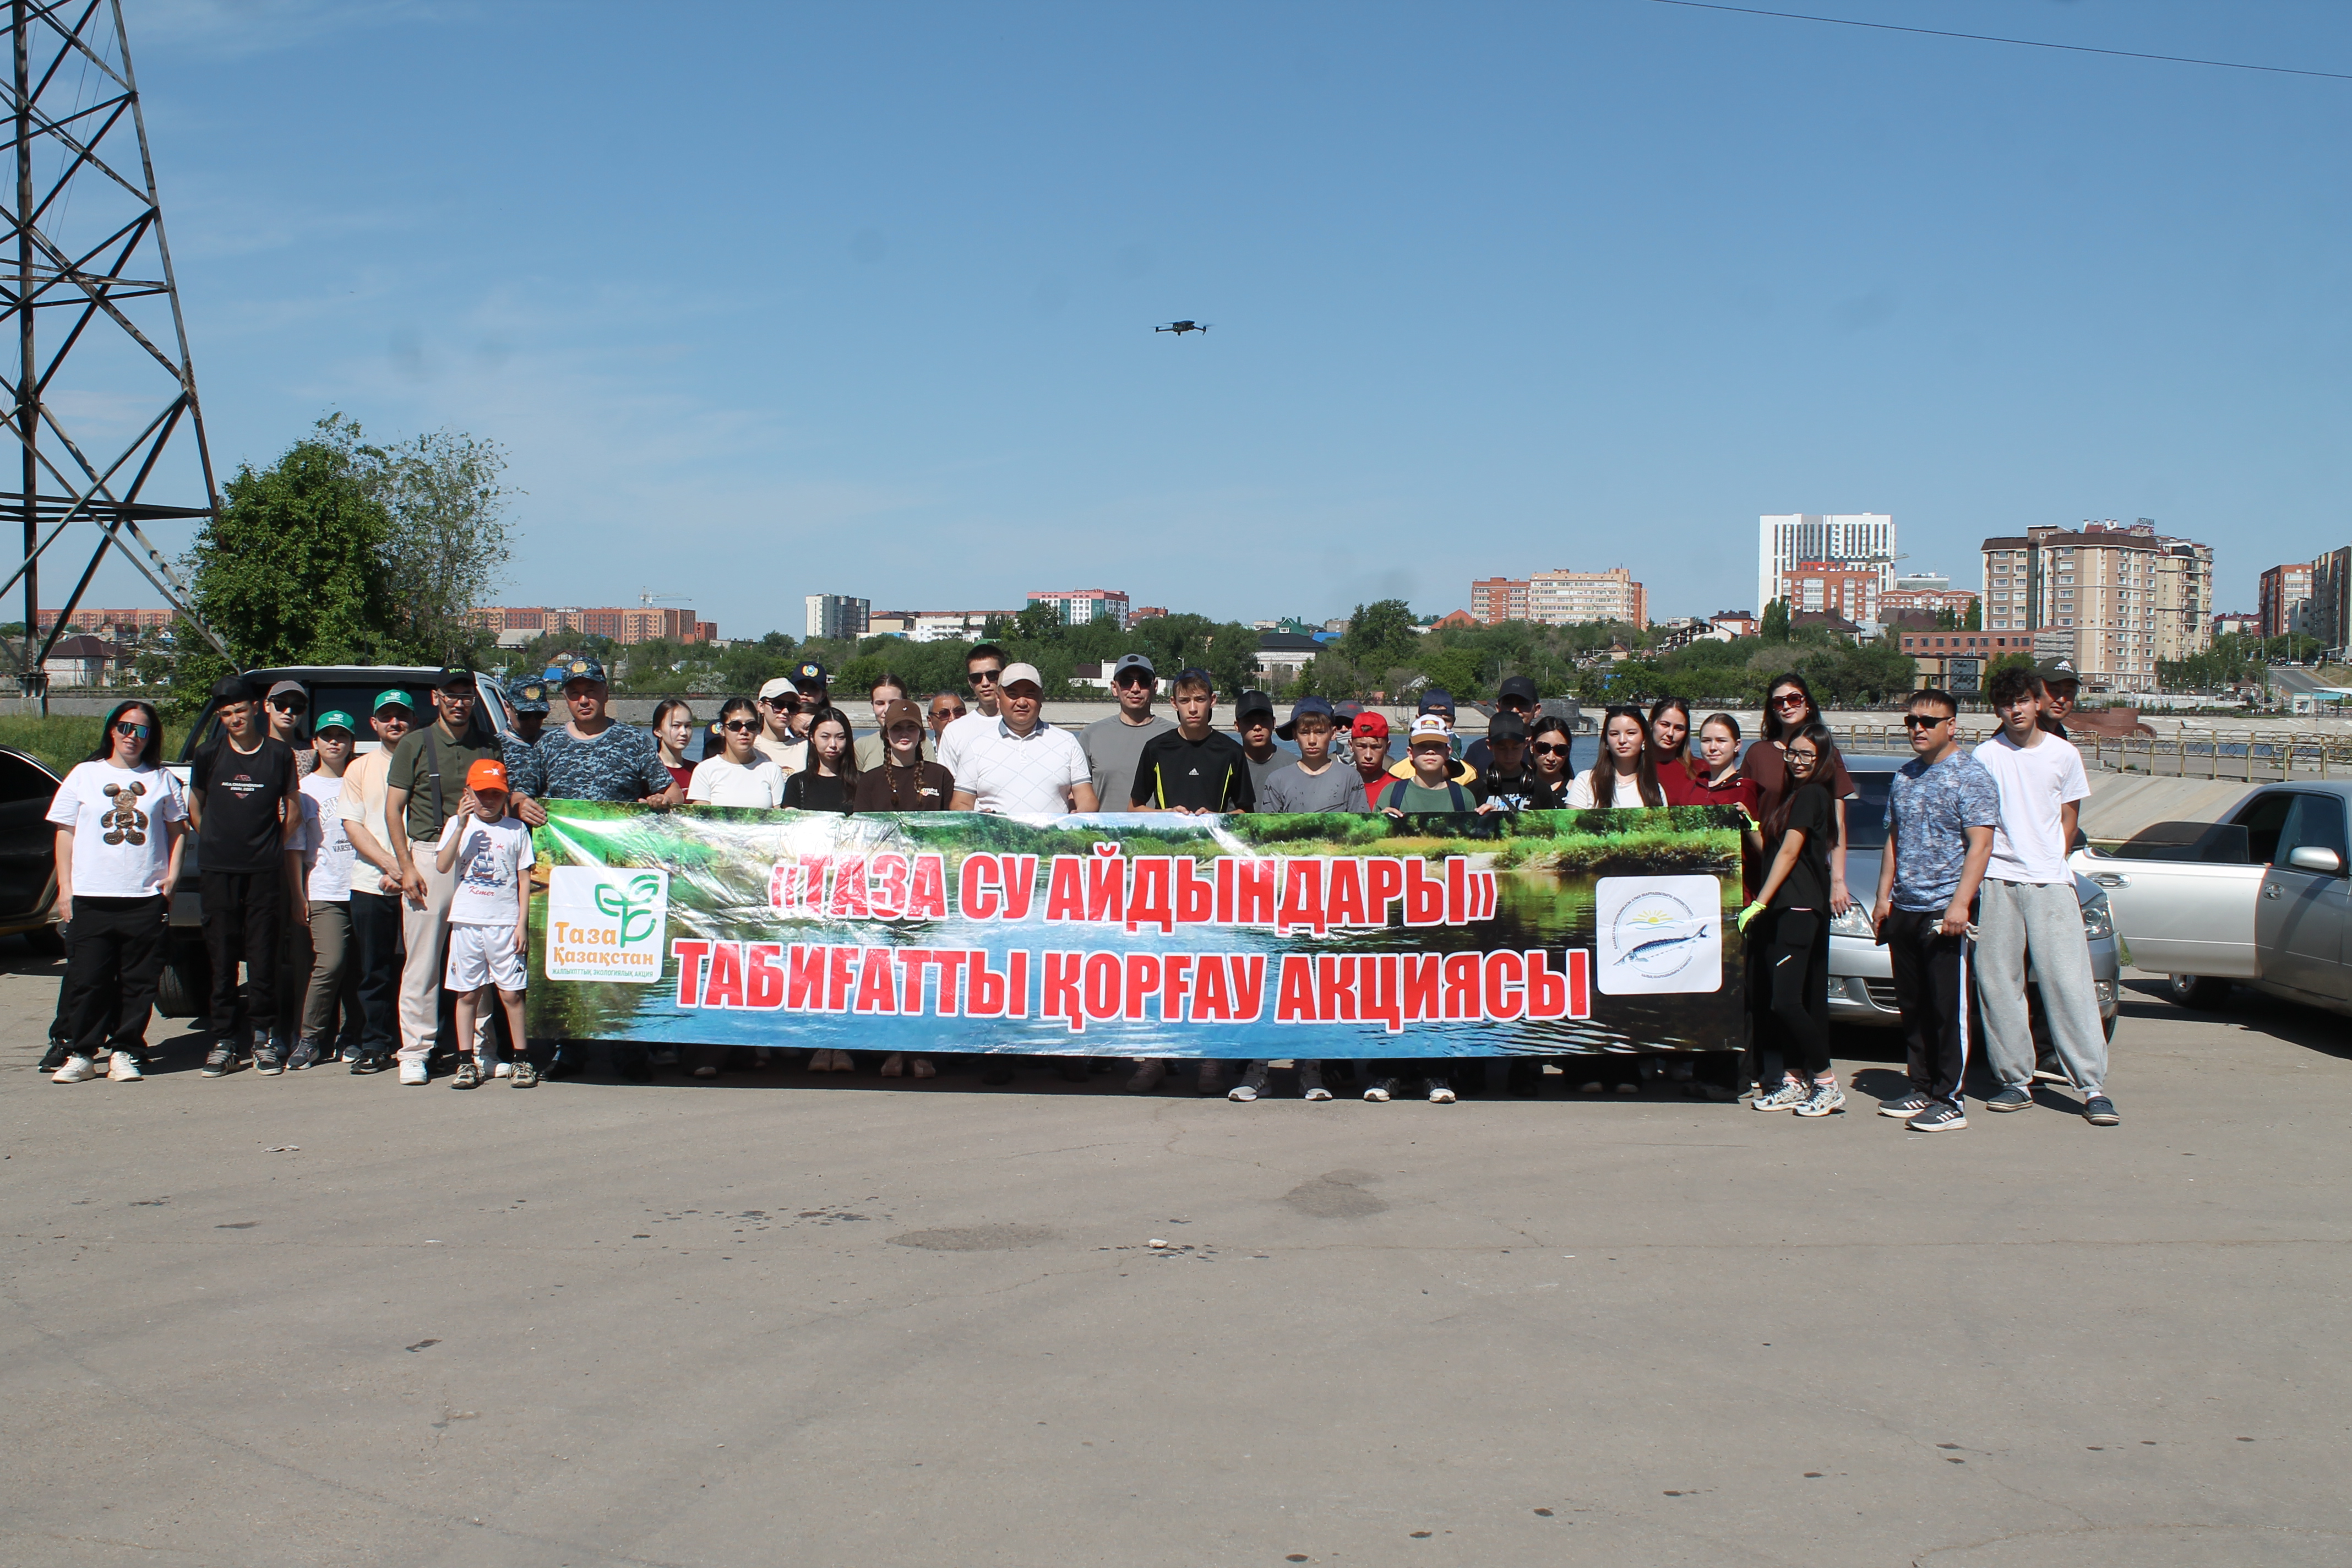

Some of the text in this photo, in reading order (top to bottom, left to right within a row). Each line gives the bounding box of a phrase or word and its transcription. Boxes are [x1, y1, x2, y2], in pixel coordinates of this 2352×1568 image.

[469, 885, 496, 896] Kemer
[961, 854, 1037, 921] СУ
[1046, 844, 1495, 935] АЙДЫНДАРЫ»
[554, 921, 617, 945] Таза
[553, 946, 654, 967] Қазақстан
[593, 969, 634, 978] ЭКОЛОГИЯЛЫҚ
[634, 970, 654, 978] АКЦИЯ
[674, 940, 1588, 1031] ТАБИҒАТТЫ ҚОРҒАУ АКЦИЯСЫ
